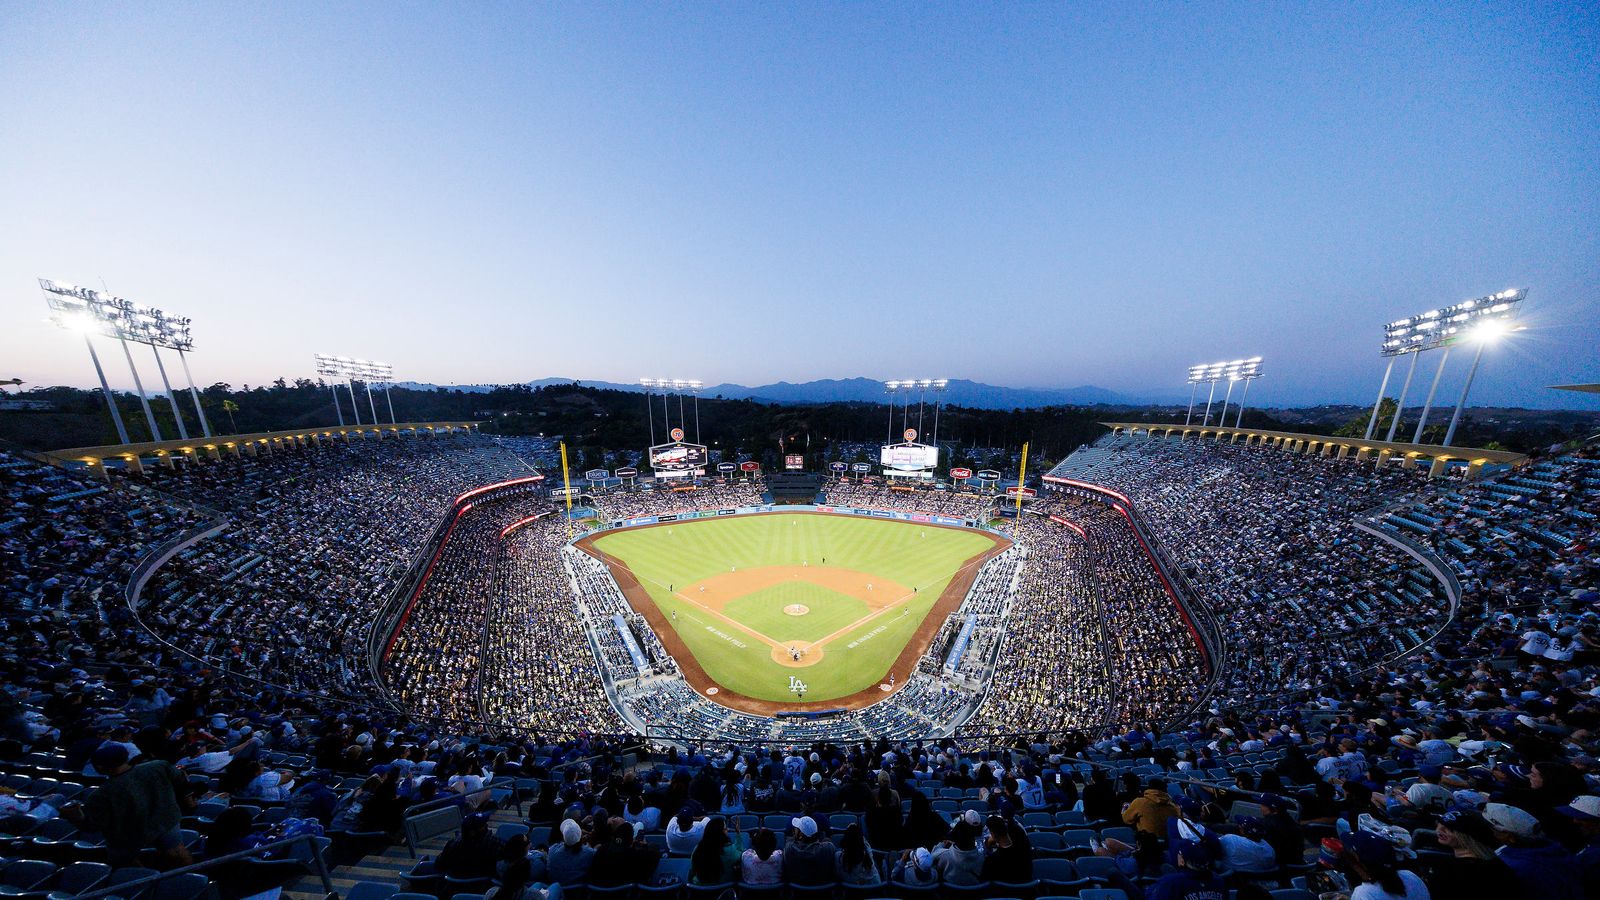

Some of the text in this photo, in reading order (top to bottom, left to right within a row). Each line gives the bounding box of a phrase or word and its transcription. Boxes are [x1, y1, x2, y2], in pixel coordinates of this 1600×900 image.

[551, 488, 579, 496] CUTWTER
[788, 675, 808, 692] LA
[787, 764, 801, 776] 34
[1032, 791, 1042, 806] 17
